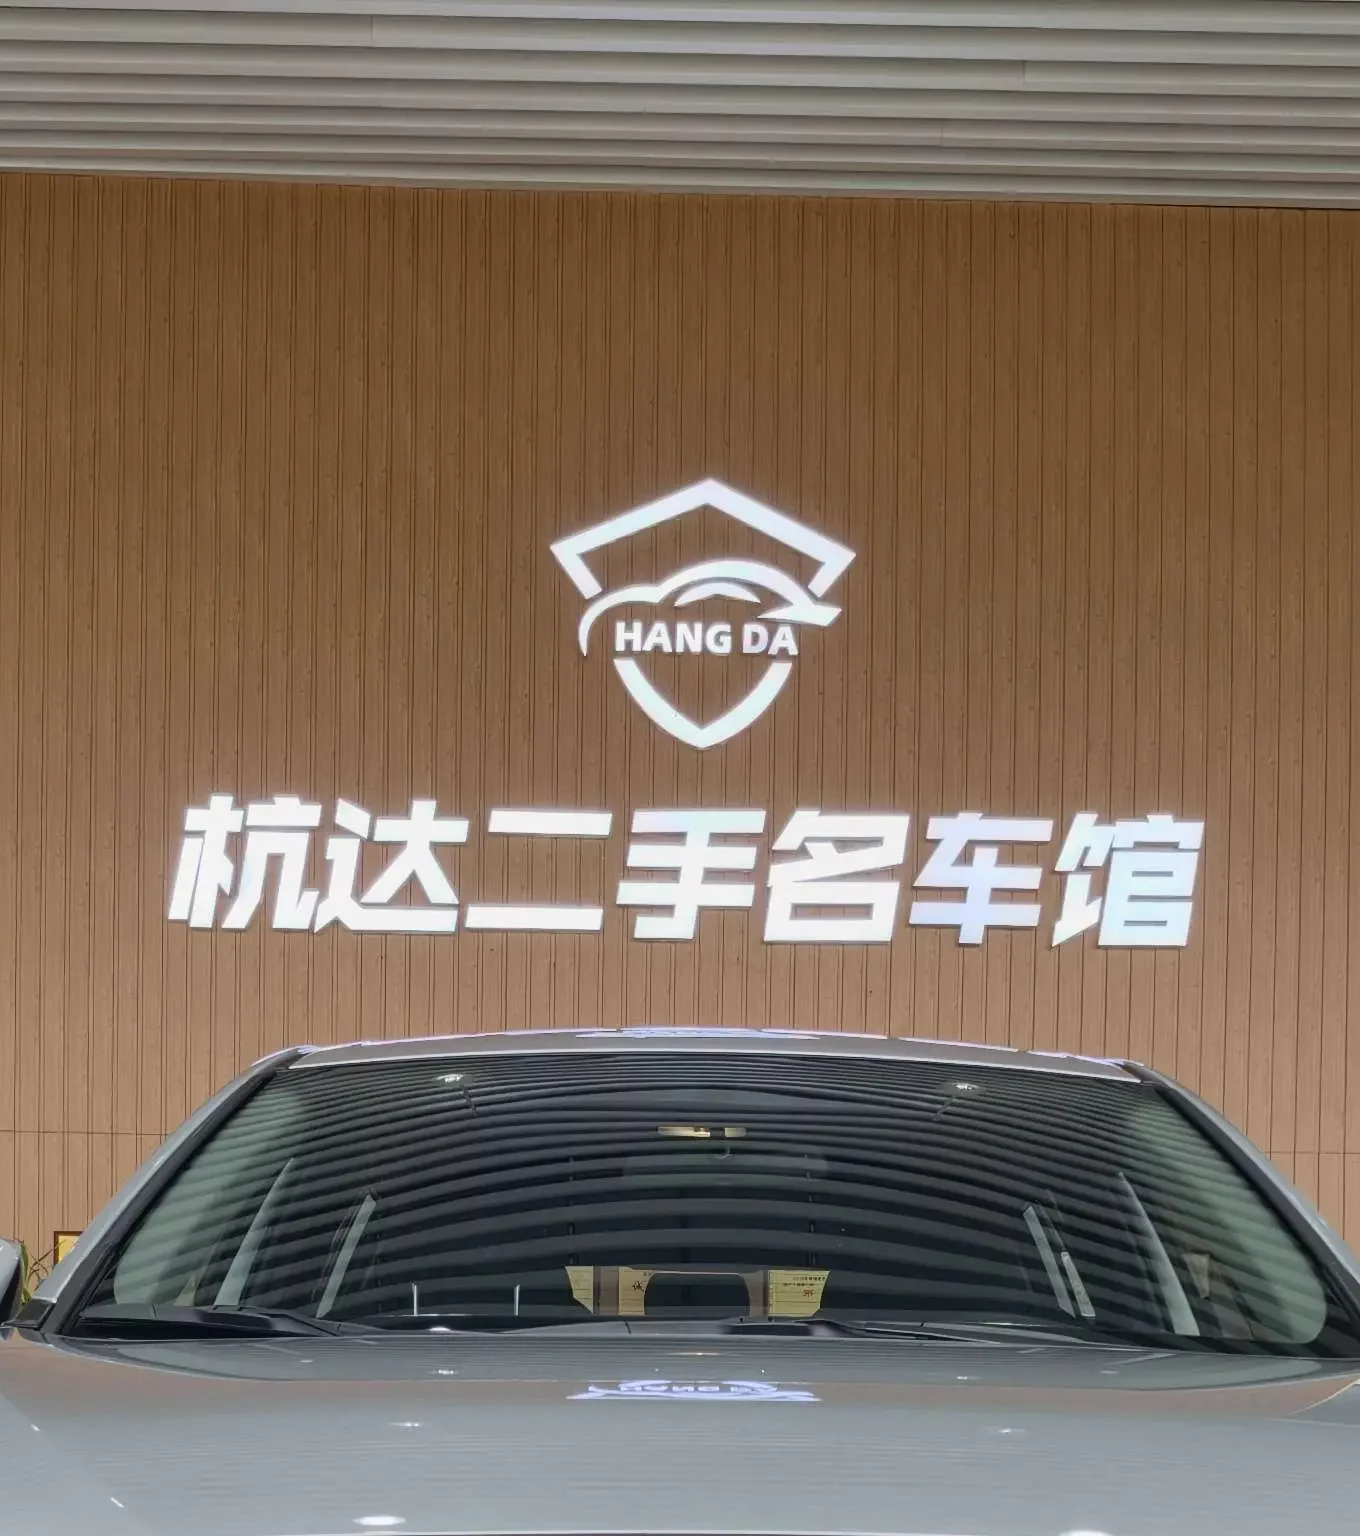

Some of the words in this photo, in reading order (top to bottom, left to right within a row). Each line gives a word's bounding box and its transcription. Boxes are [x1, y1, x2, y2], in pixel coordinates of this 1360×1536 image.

[615, 621, 732, 656] HANG
[741, 622, 800, 657] DA
[168, 793, 1206, 949] 杭达二手名车馆
